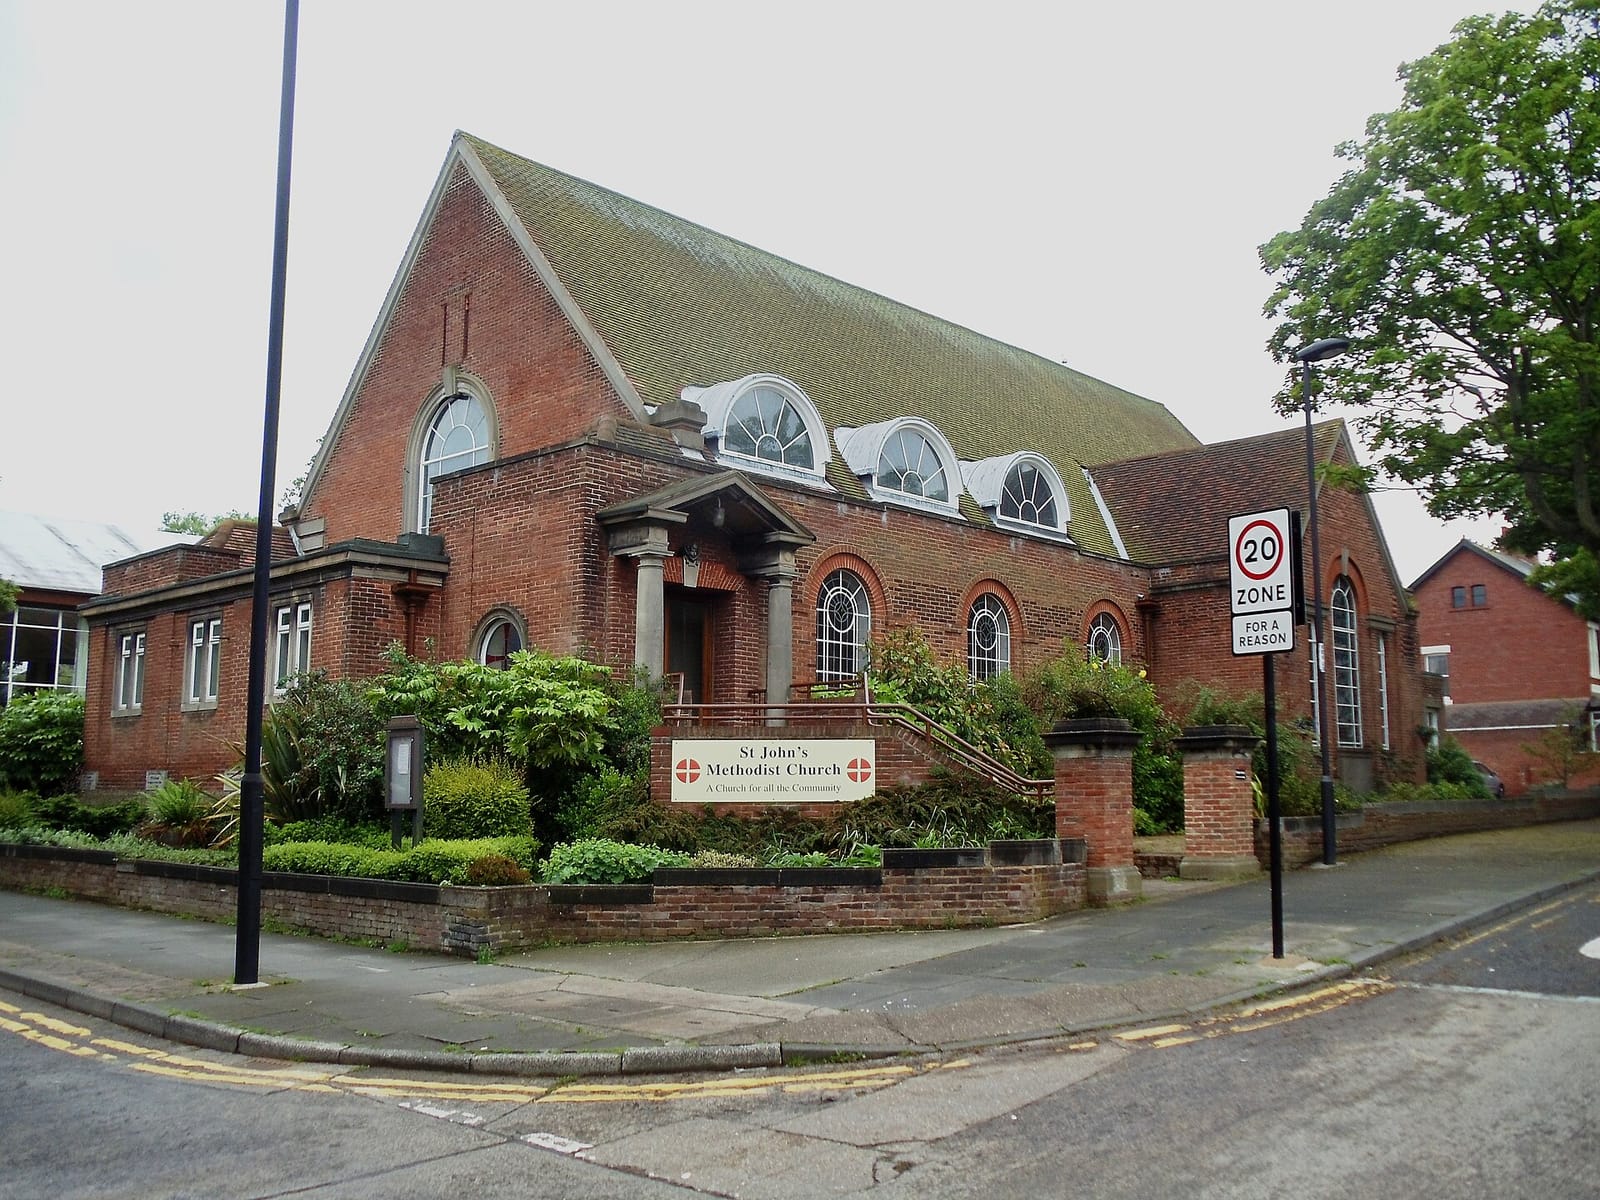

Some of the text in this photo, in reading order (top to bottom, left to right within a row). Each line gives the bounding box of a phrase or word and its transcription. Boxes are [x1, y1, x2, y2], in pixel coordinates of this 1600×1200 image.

[1244, 536, 1276, 563] 20
[1237, 584, 1286, 605] ZONE
[1245, 620, 1279, 633] FOR A
[1239, 633, 1286, 647] REASON
[740, 746, 808, 759] St John's
[706, 763, 841, 776] Methodist Church
[706, 784, 841, 794] A Church for all the Community
